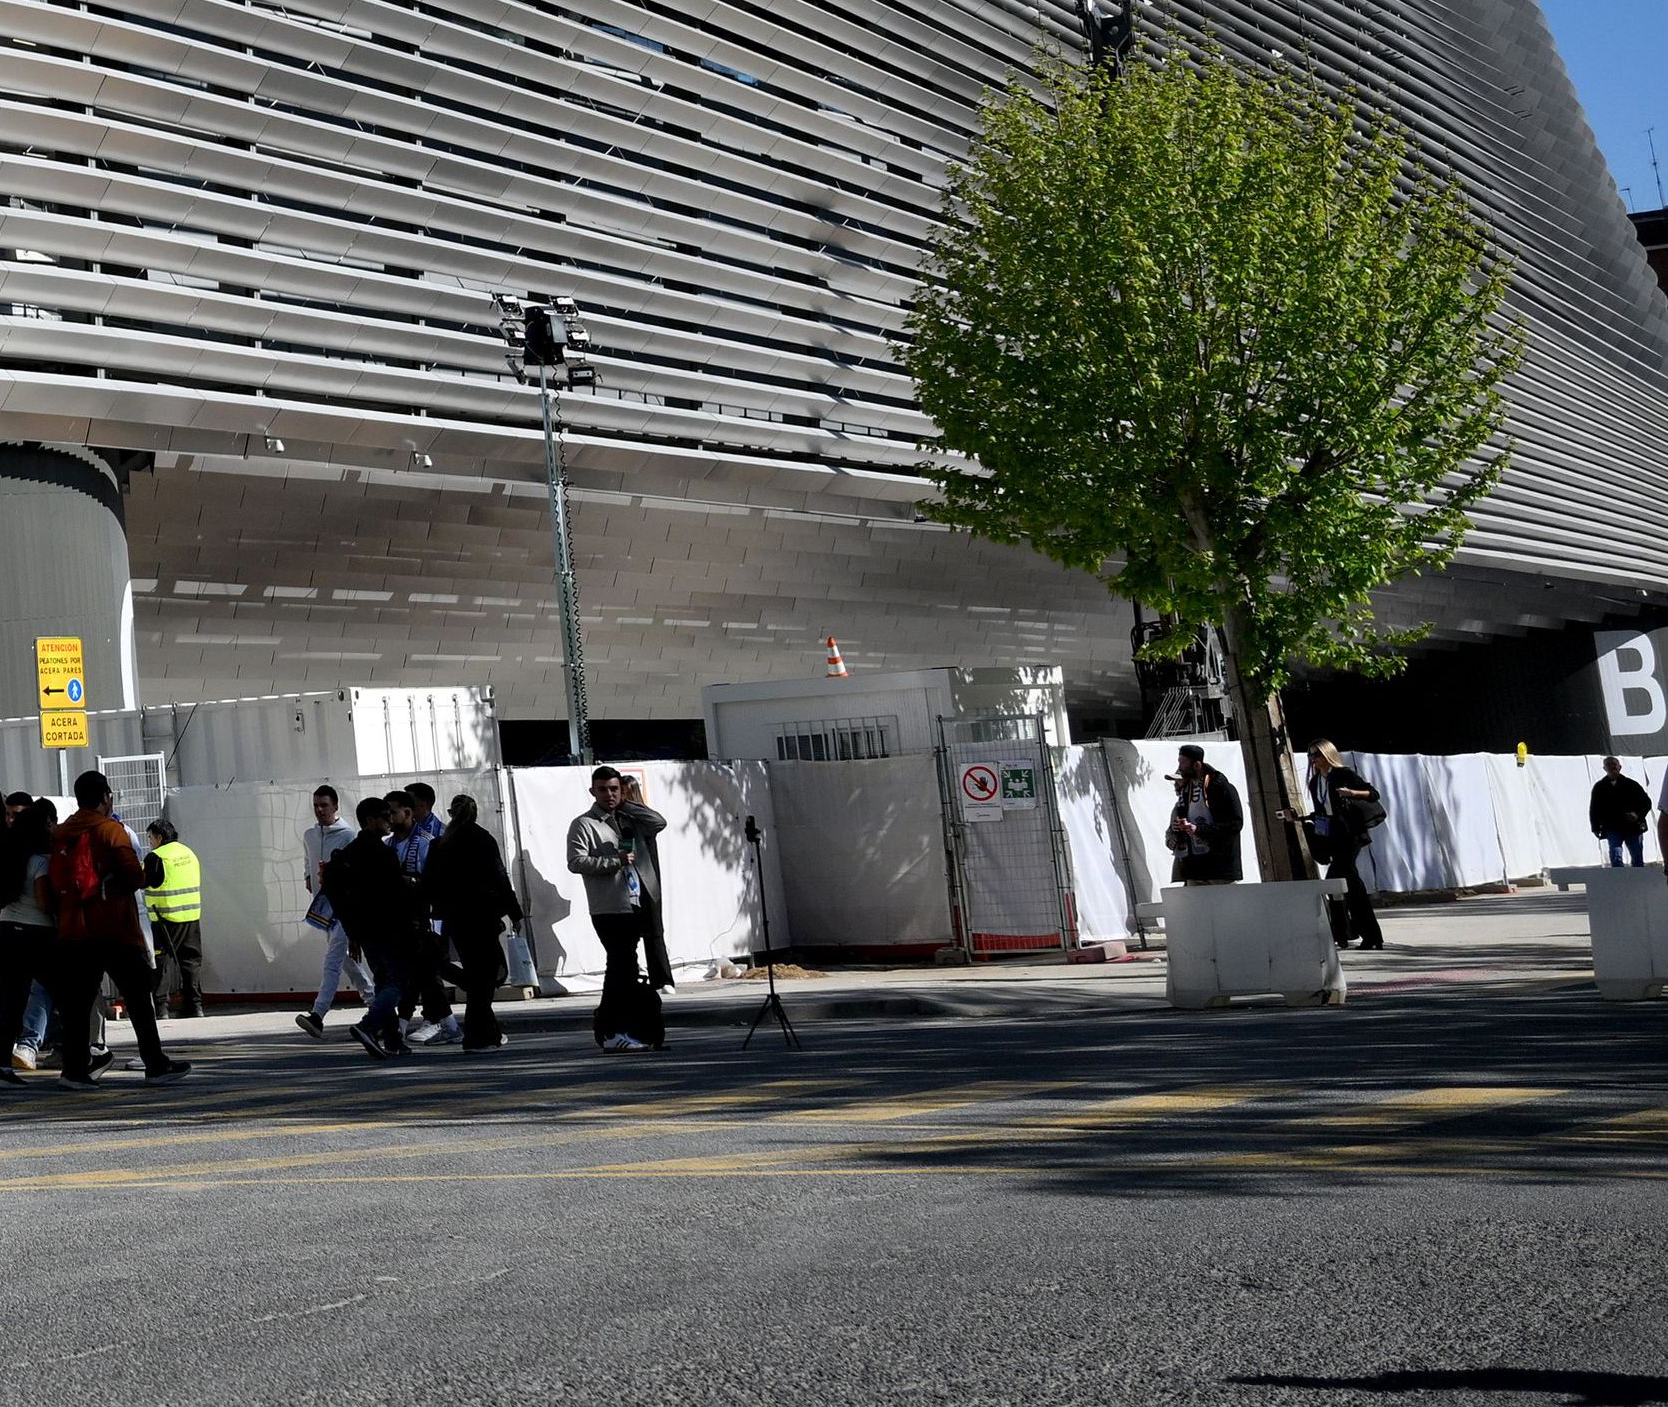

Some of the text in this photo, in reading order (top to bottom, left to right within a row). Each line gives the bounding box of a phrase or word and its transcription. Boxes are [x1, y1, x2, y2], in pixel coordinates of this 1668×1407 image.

[40, 666, 82, 675] ACERA PARES
[1593, 630, 1667, 736] B
[51, 717, 78, 727] ACERA
[45, 731, 84, 741] CORTADA
